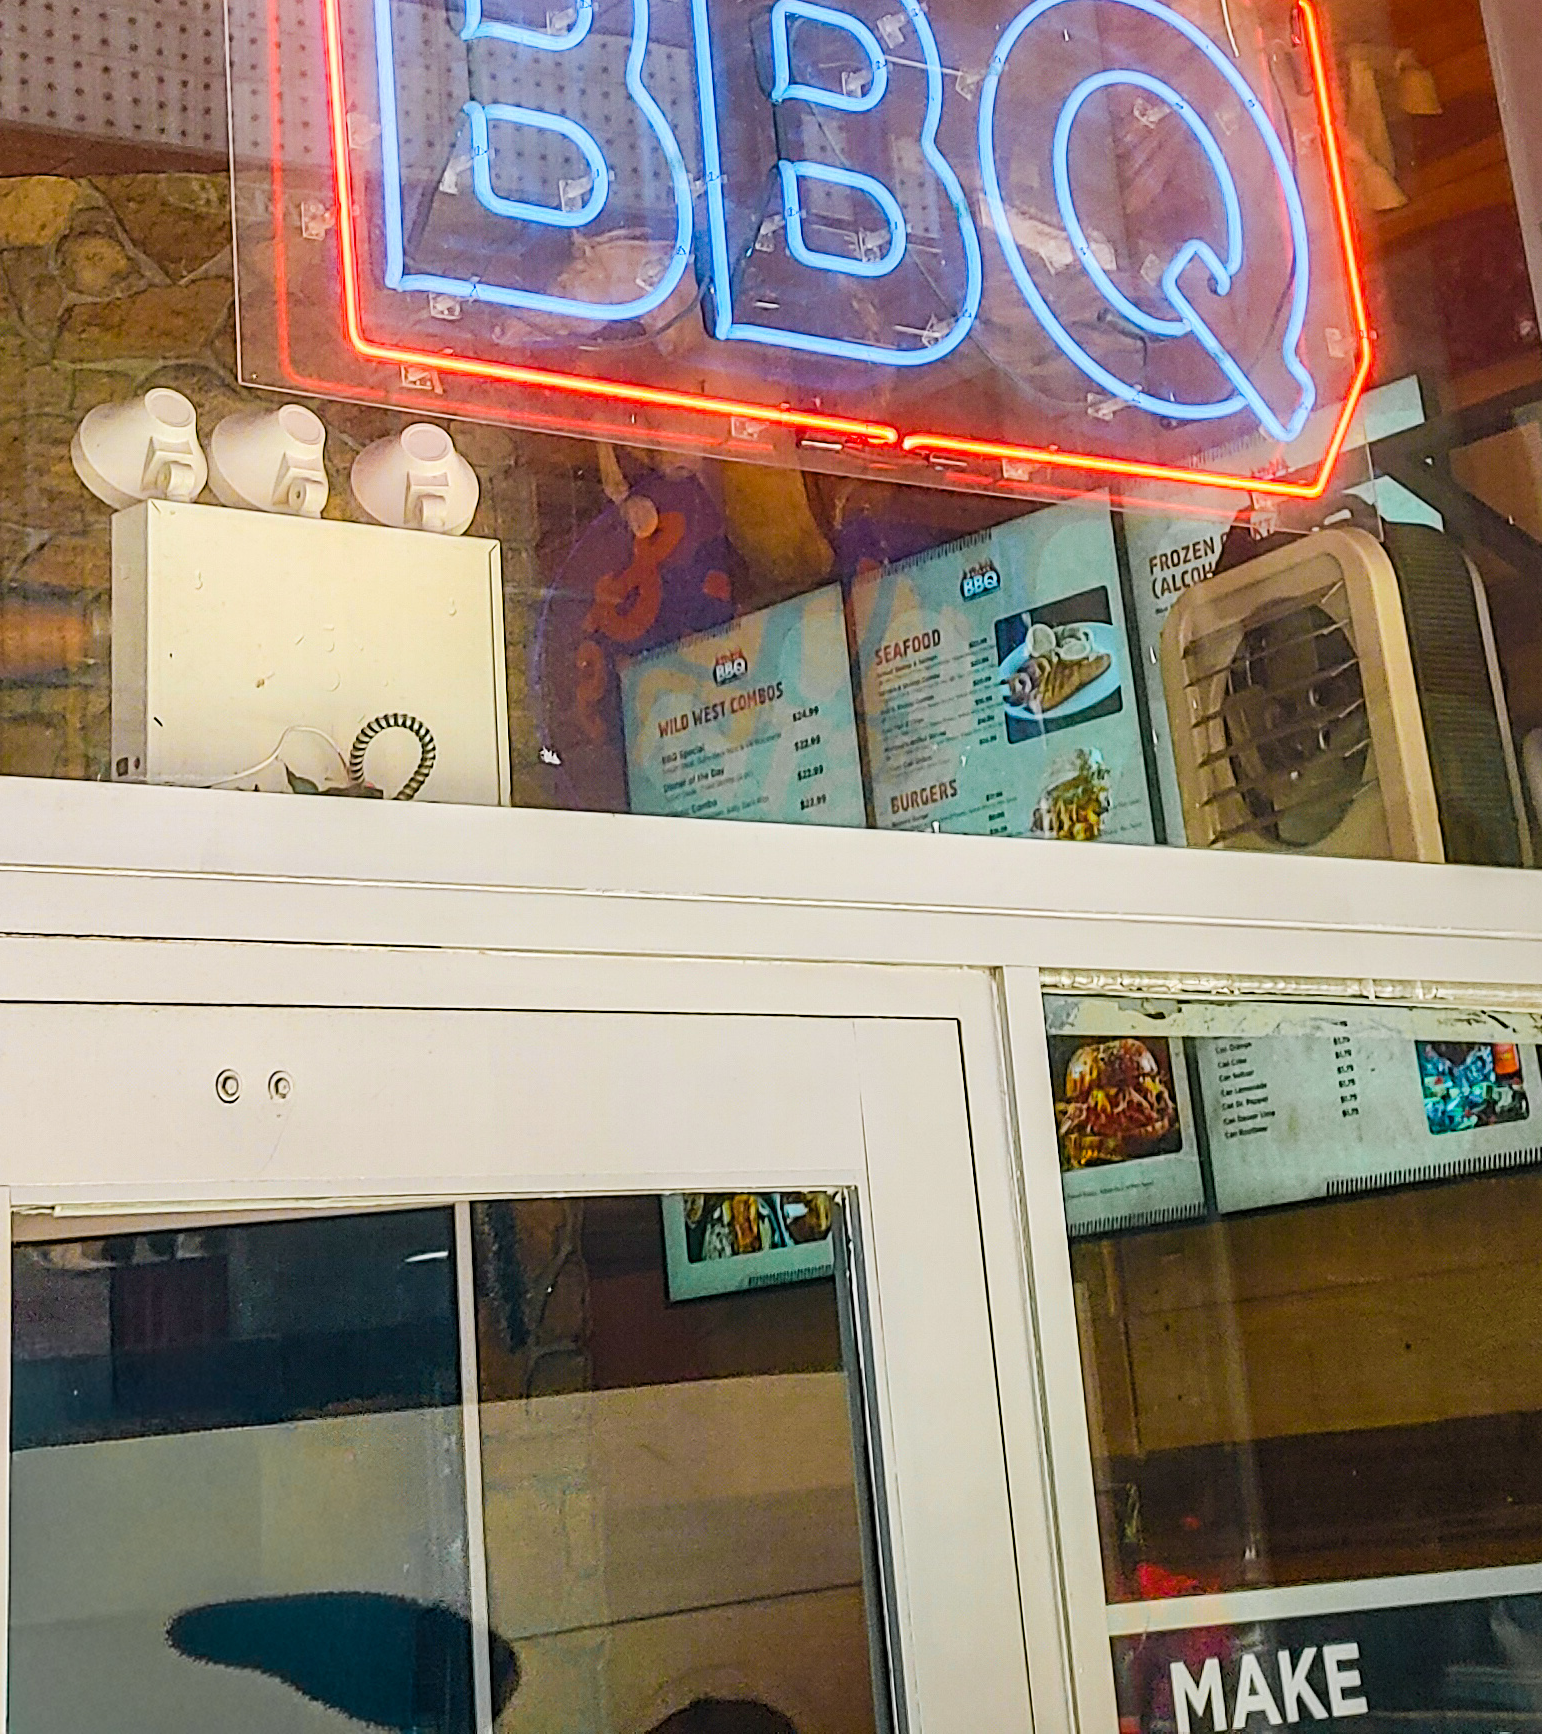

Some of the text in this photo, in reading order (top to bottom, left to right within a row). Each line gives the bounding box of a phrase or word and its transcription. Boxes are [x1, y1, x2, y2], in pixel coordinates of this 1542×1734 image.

[1149, 536, 1215, 576] FROZEN
[963, 570, 999, 598] BBQ
[874, 628, 941, 666] SEAFOOD
[657, 681, 784, 738] WILD WEST COMBOS
[890, 778, 958, 815] BURGERS
[1170, 1642, 1369, 1734] MAKE
